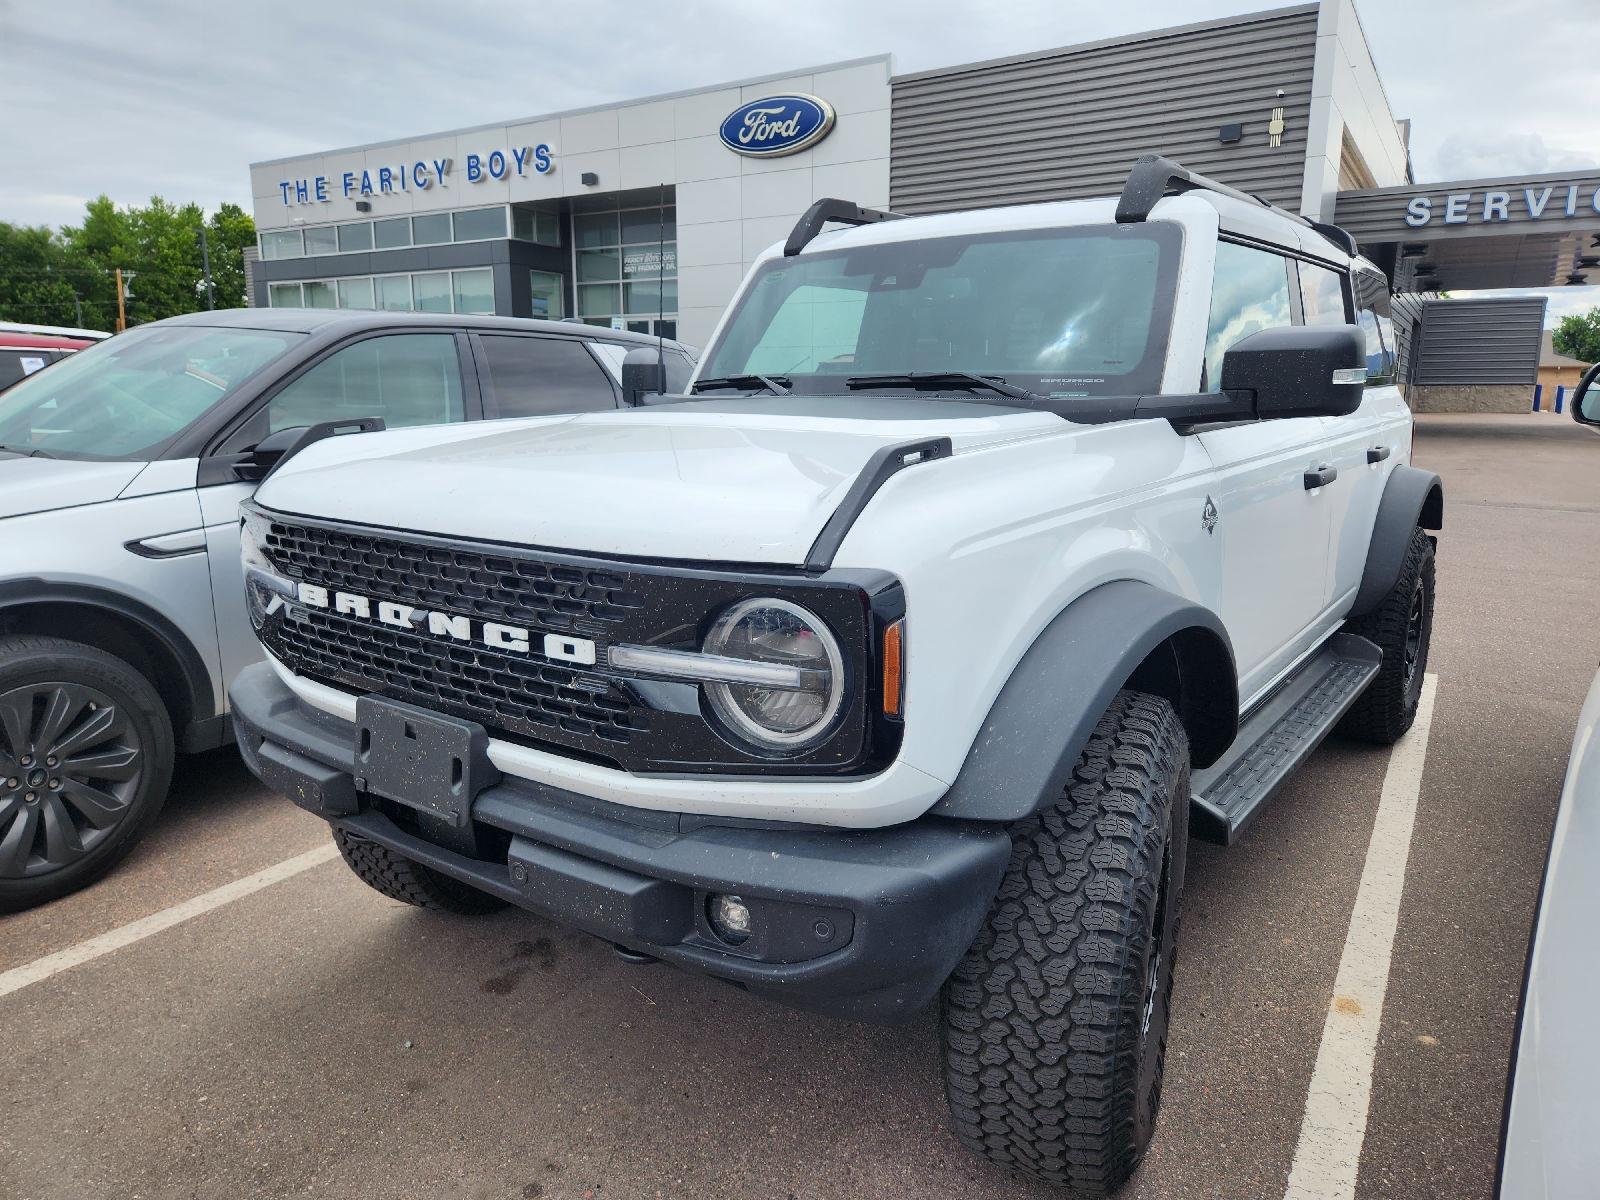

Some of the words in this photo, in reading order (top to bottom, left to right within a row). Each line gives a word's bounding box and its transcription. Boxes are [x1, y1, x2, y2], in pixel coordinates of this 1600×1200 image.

[738, 105, 802, 144] Ford
[279, 176, 328, 205] THE
[343, 159, 447, 197] FARICY
[466, 144, 551, 182] BOYS
[298, 583, 597, 666] BRONCO
